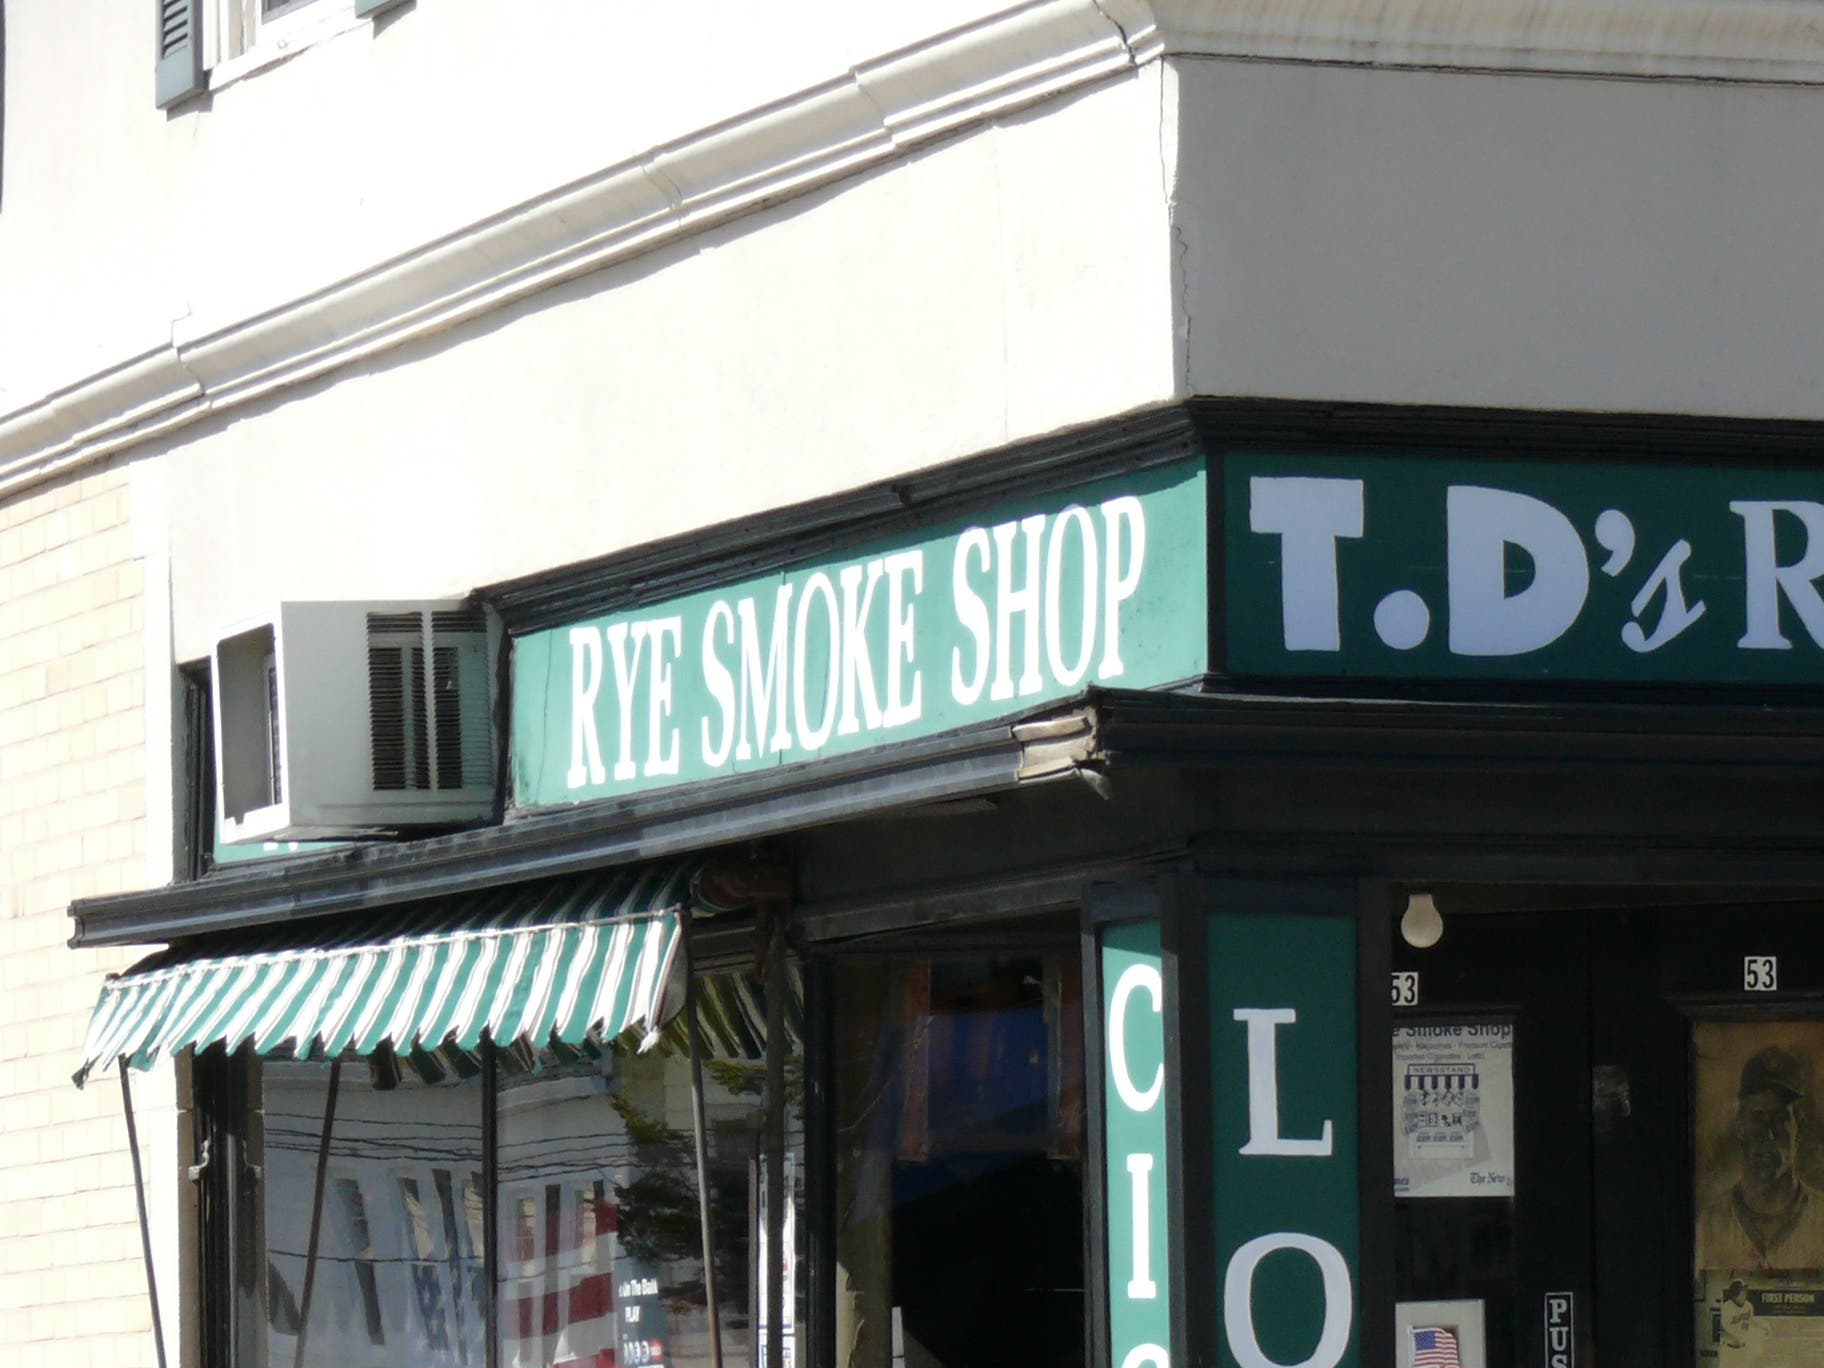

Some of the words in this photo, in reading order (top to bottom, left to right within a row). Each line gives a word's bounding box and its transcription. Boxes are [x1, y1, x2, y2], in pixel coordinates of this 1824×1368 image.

[566, 615, 682, 789] RYE
[700, 549, 926, 768] SMOKE
[950, 495, 1146, 706] SHOP
[1249, 476, 1705, 656] T.D's
[1746, 958, 1775, 989] 53
